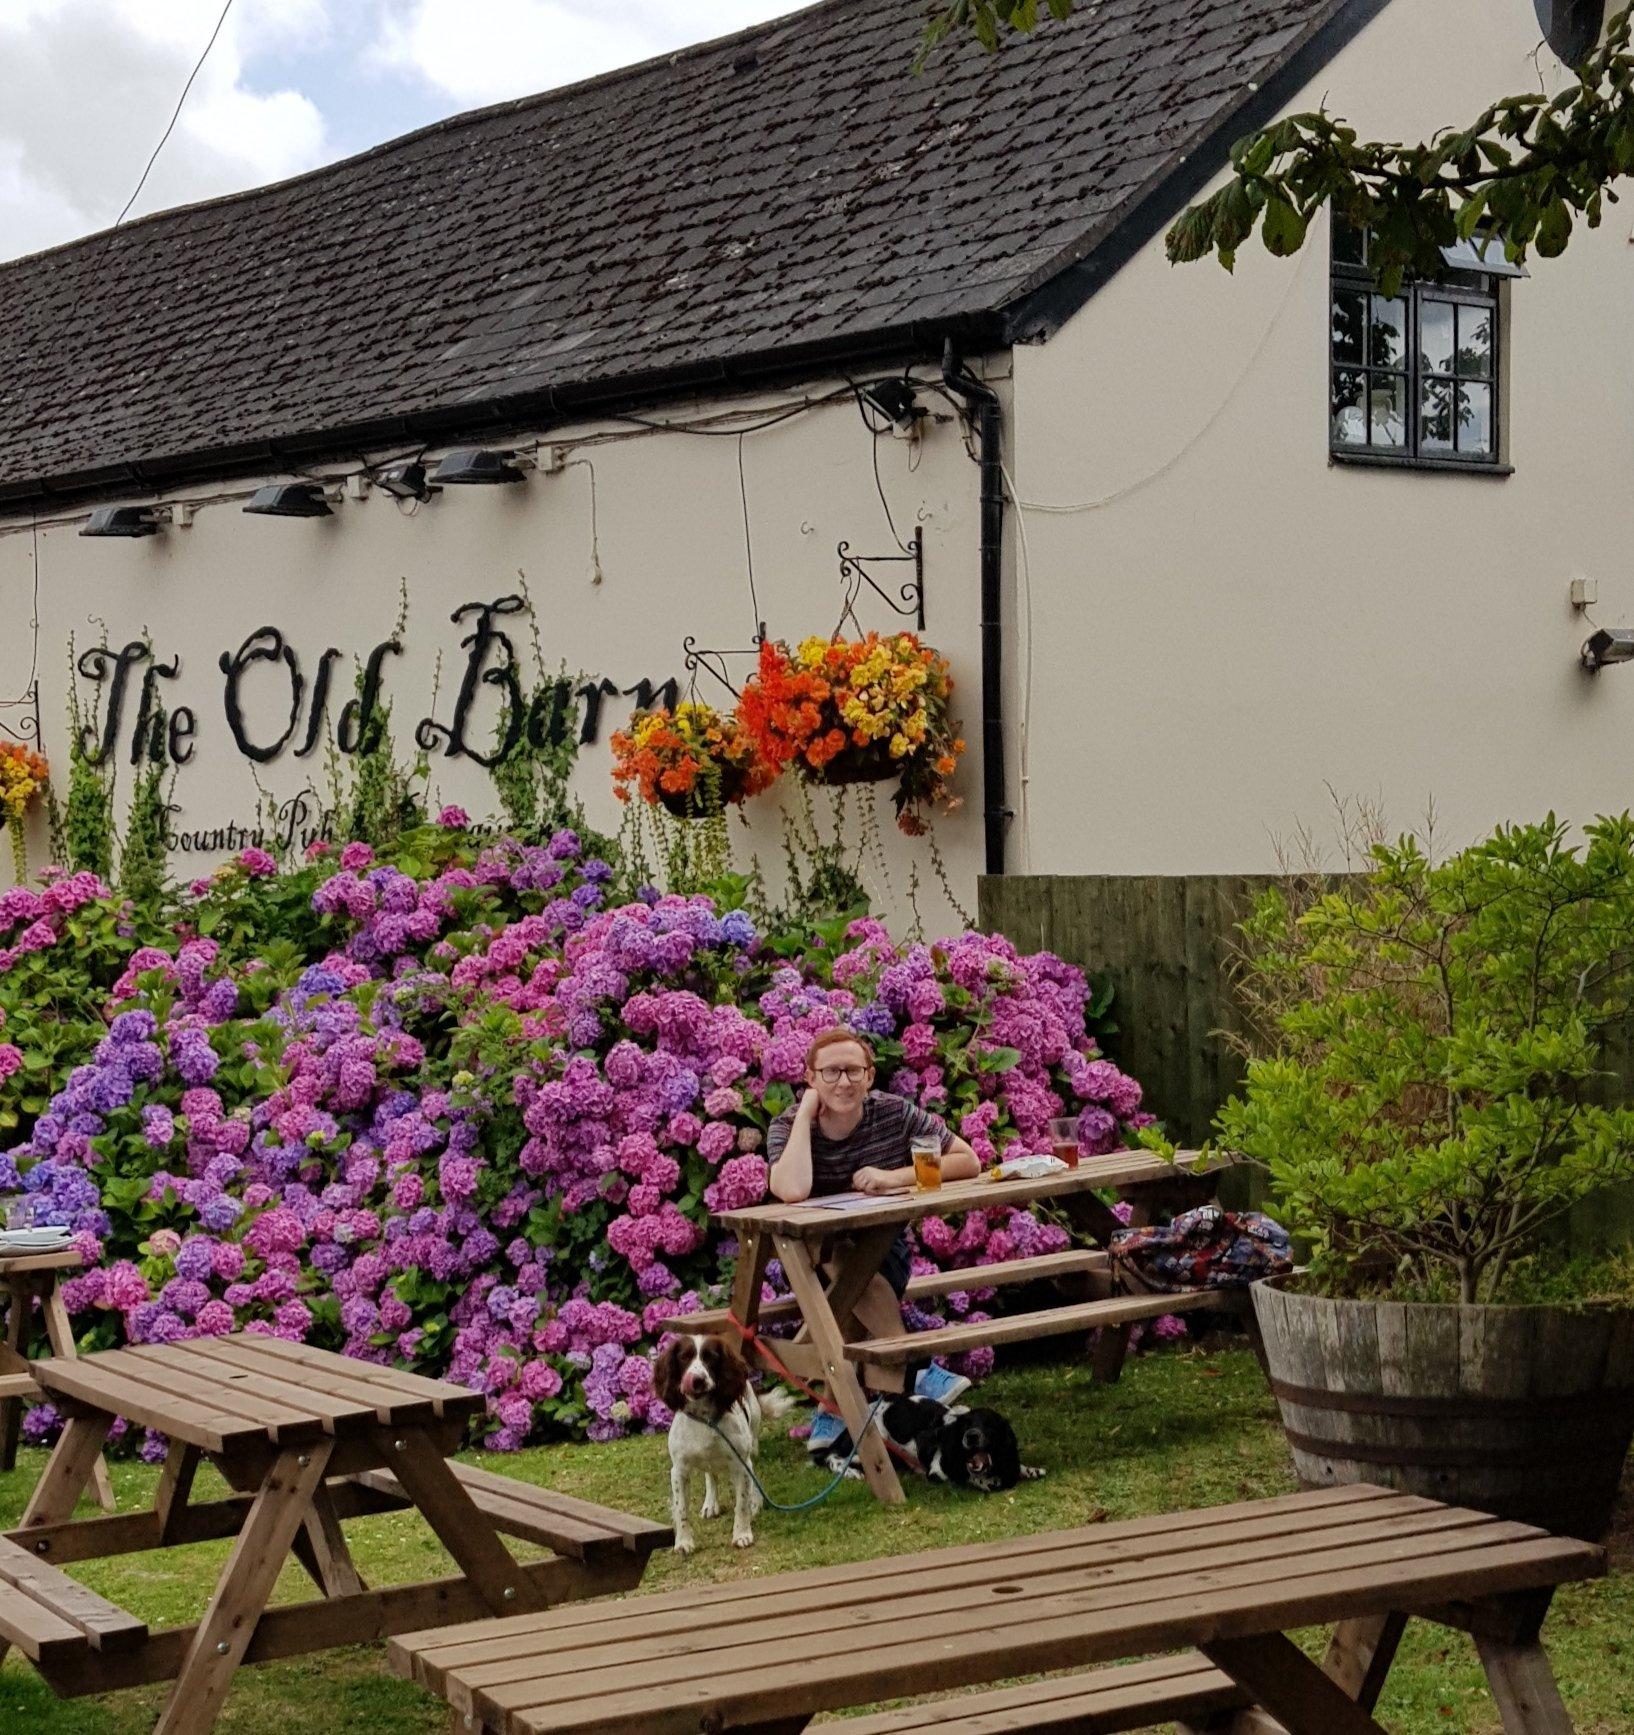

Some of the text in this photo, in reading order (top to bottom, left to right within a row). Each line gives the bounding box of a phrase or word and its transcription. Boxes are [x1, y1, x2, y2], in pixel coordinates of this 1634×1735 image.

[78, 593, 679, 768] The Old Barn
